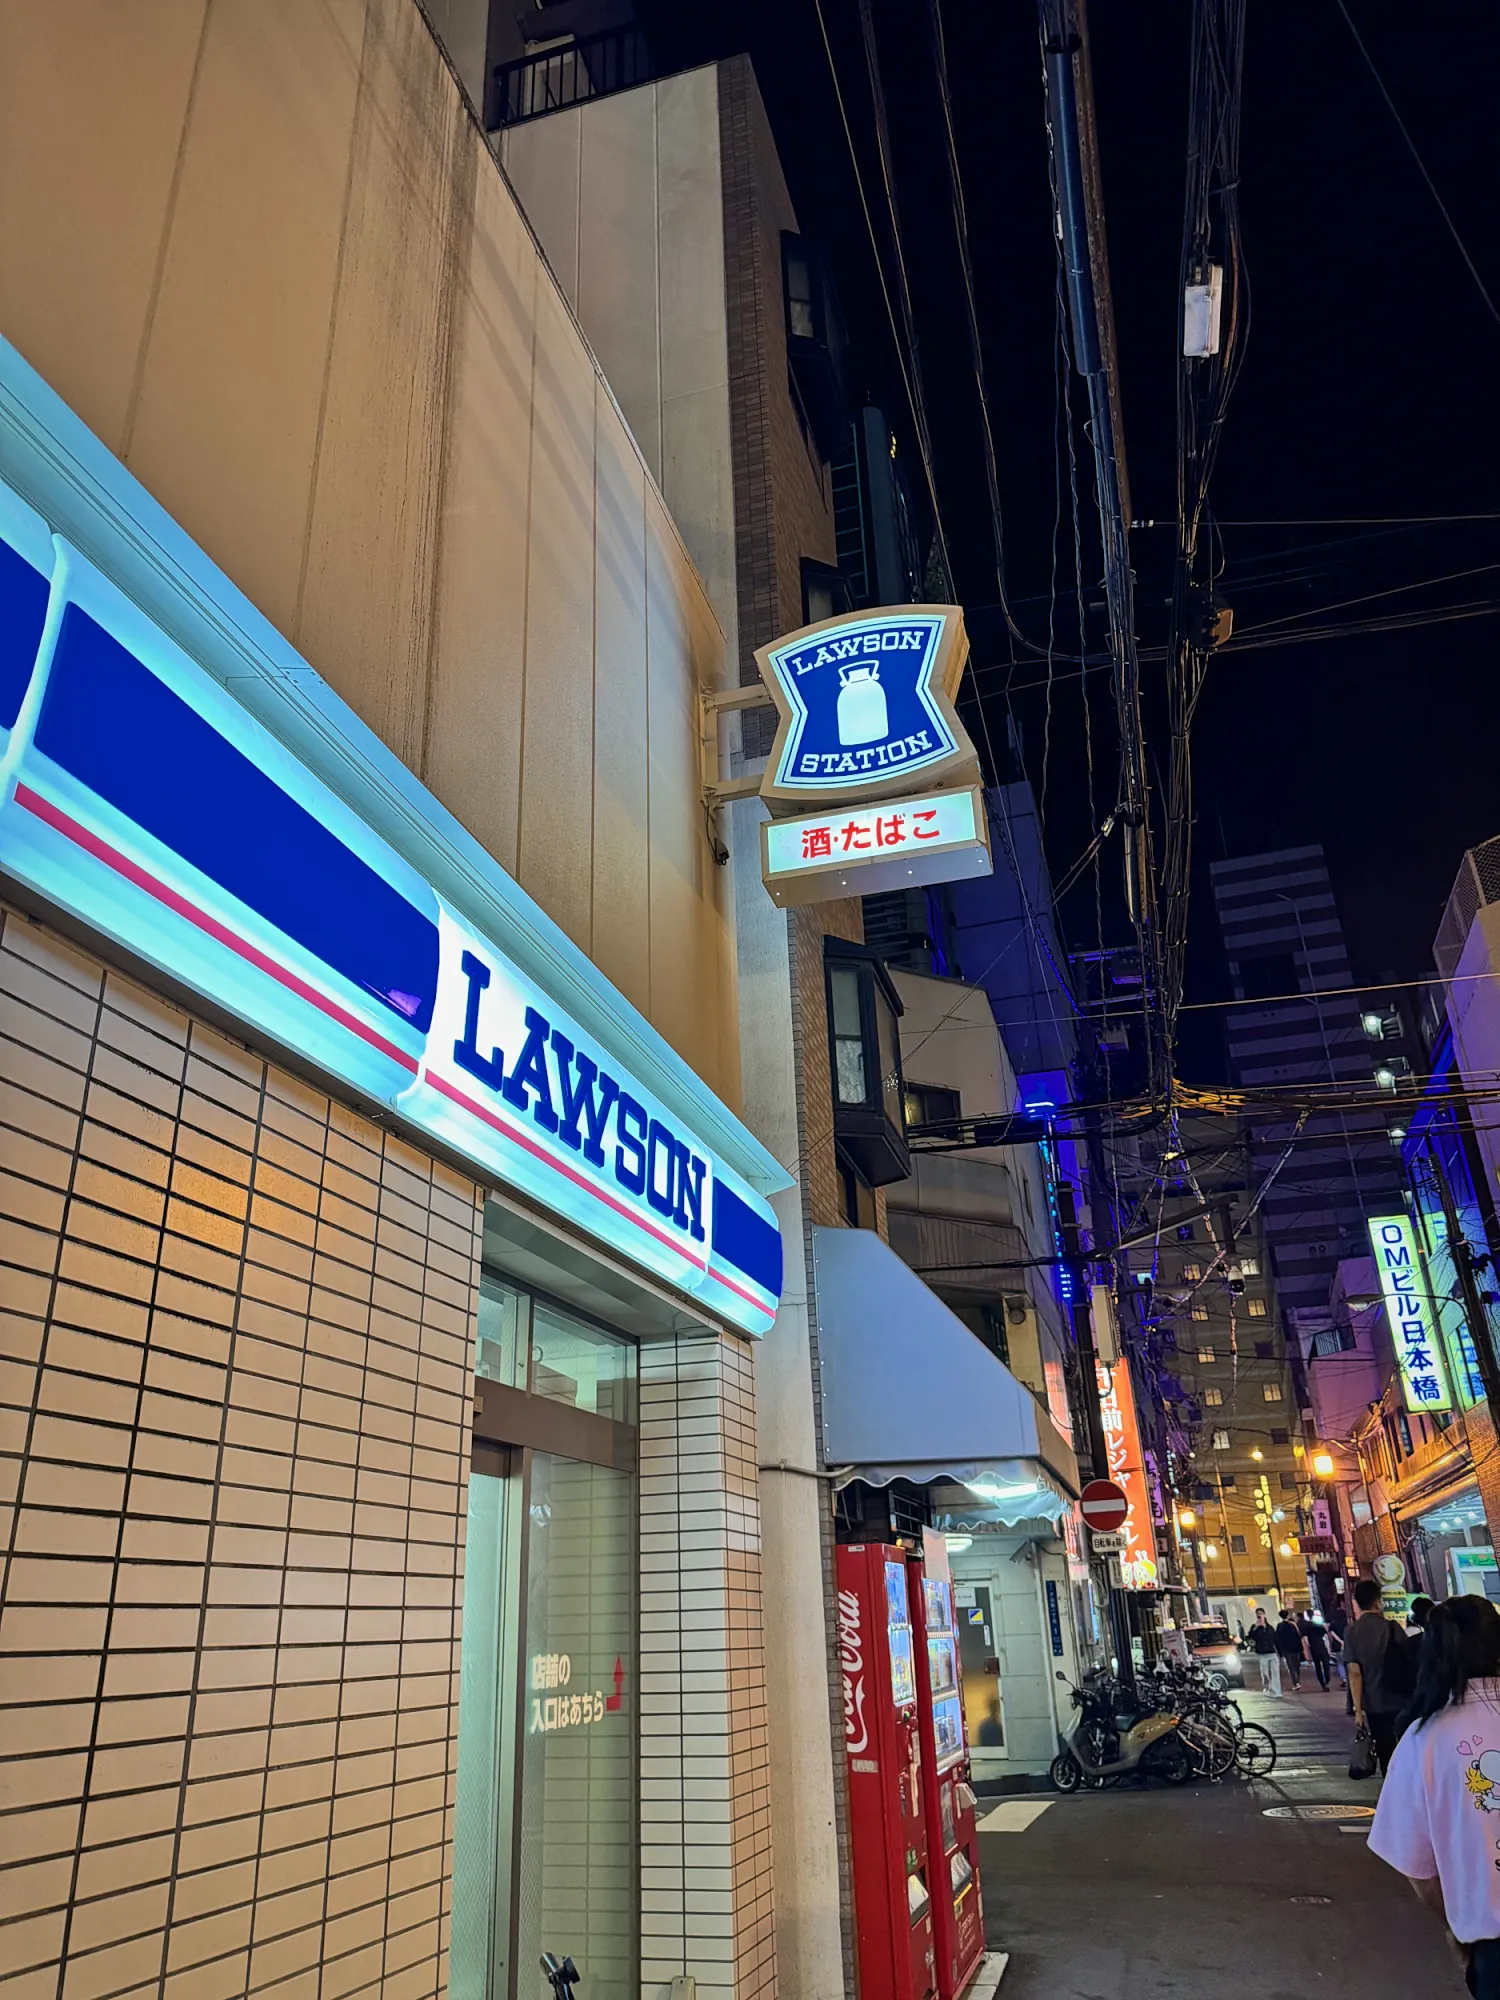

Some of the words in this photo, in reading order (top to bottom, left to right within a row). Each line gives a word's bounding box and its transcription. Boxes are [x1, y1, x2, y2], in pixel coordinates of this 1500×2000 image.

[791, 631, 924, 677] LAWSON
[800, 730, 933, 774] STATION
[453, 949, 707, 1243] LAWSON
[1381, 1223, 1442, 1402] OMビル日本橋
[532, 1653, 571, 1690] 店舗の
[530, 1690, 604, 1734] 入口はあちら
